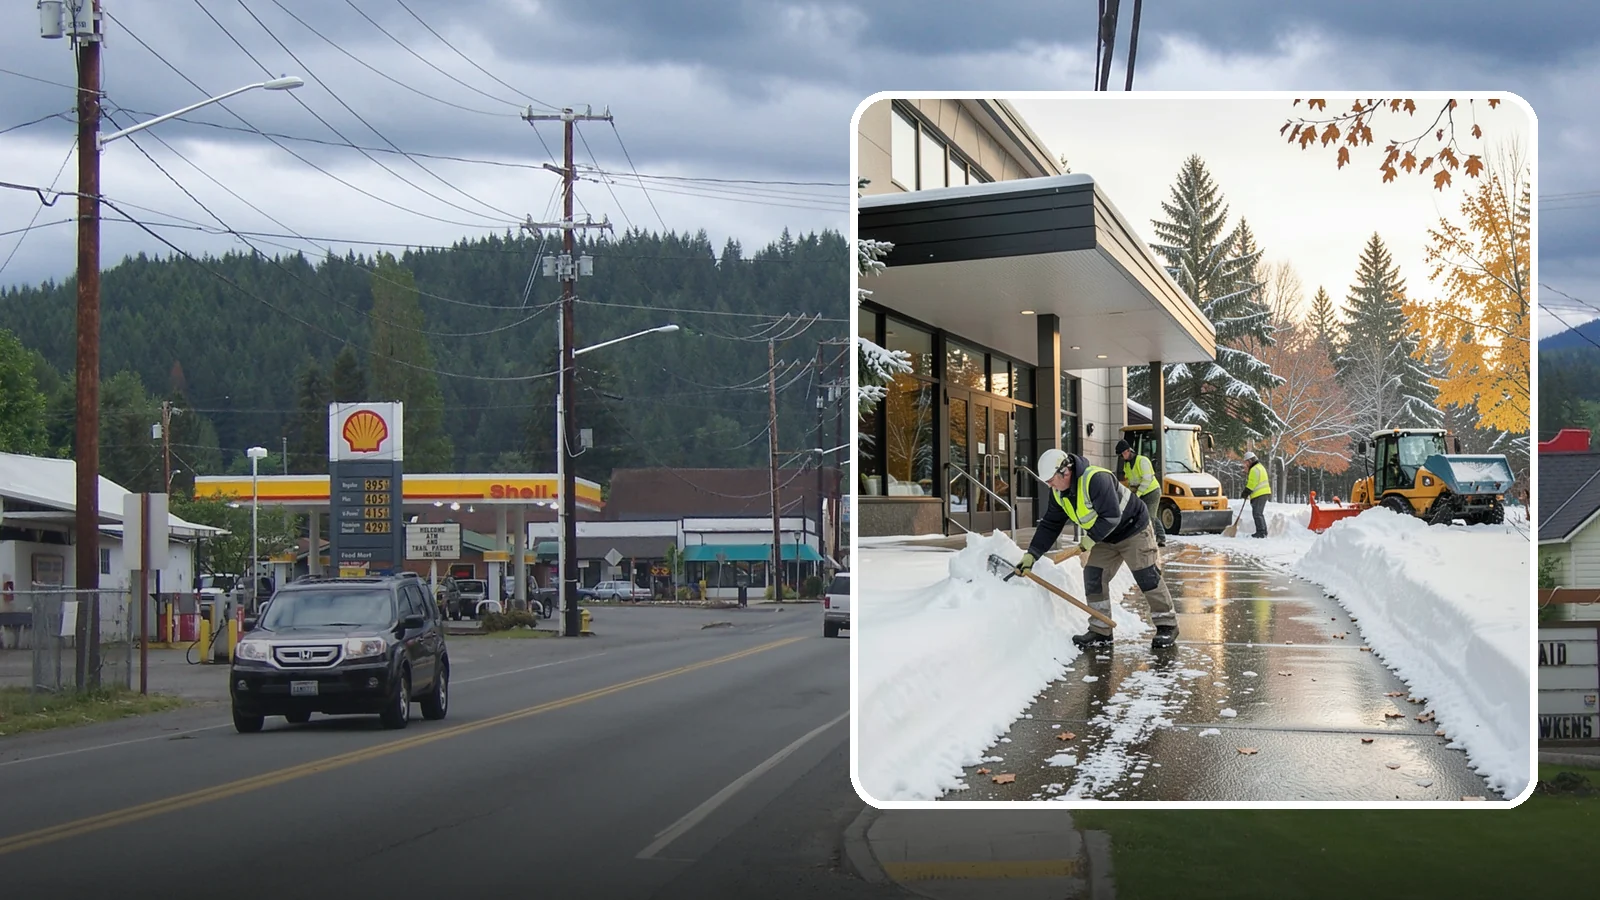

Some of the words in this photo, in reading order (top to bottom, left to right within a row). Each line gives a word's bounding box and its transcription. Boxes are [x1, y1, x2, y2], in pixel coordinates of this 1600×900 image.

[366, 480, 383, 490] 395
[490, 484, 547, 499] Shell
[366, 494, 383, 504] 405
[366, 508, 383, 518] 415
[366, 522, 383, 532] 429
